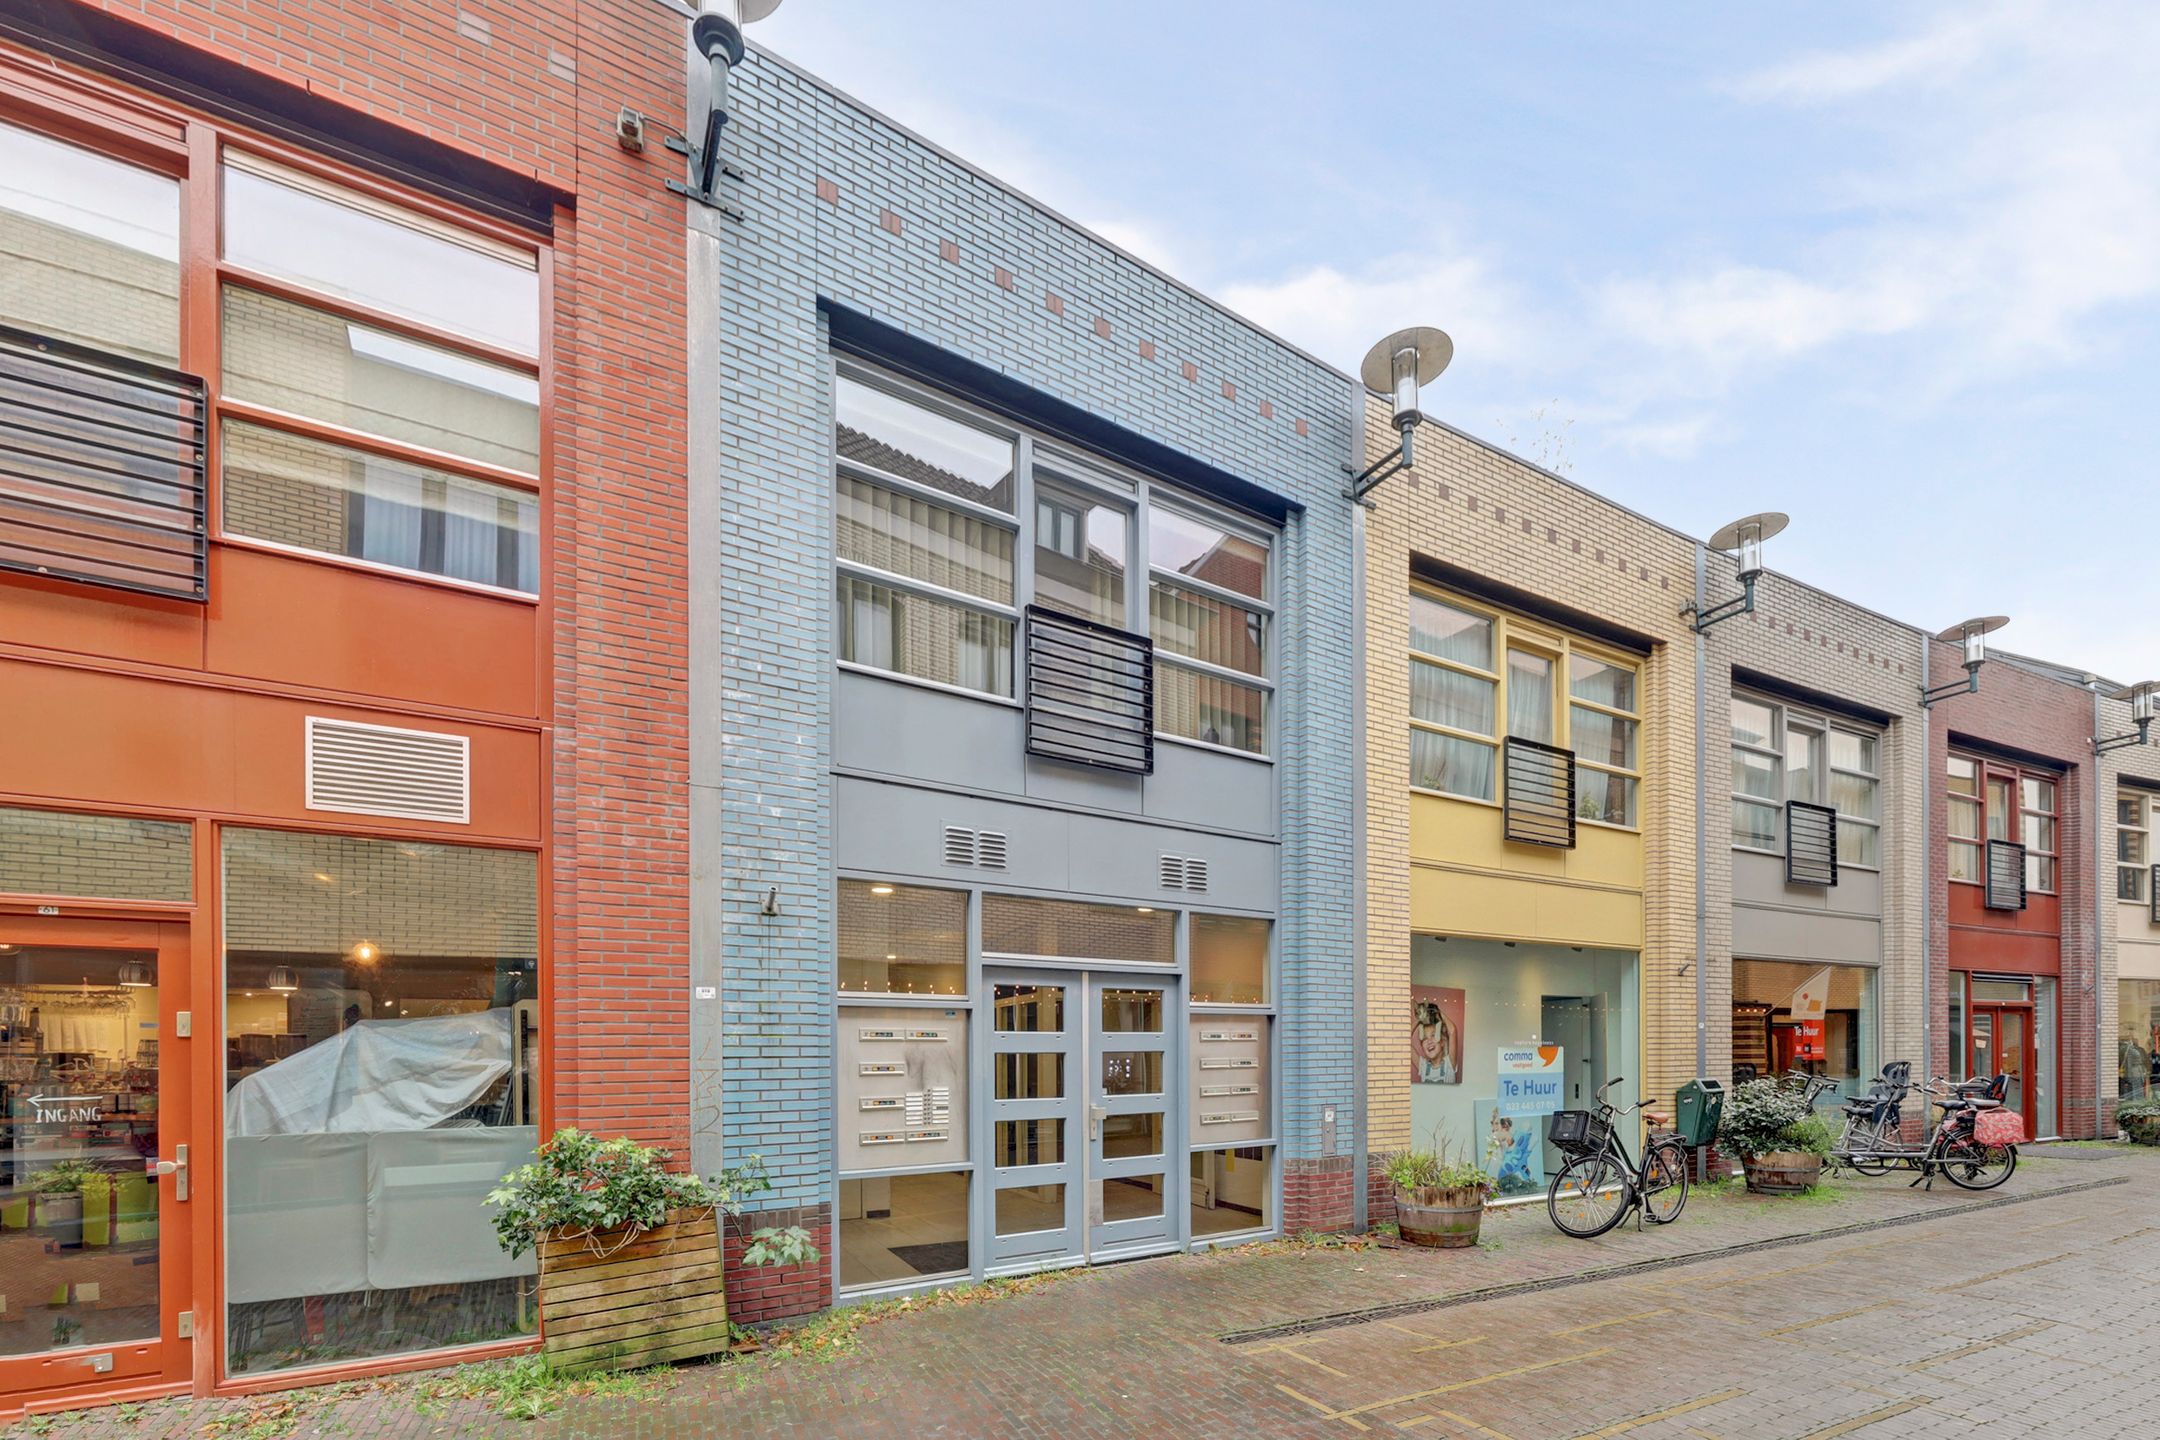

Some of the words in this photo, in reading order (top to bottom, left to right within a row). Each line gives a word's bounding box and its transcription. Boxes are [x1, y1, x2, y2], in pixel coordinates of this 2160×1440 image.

[1794, 1026, 1802, 1037] Te
[1803, 1025, 1820, 1037] Huur
[1503, 1052, 1533, 1061] comma
[1503, 1080, 1519, 1096] Te
[1524, 1080, 1557, 1095] Huur
[35, 1106, 101, 1123] INGANG
